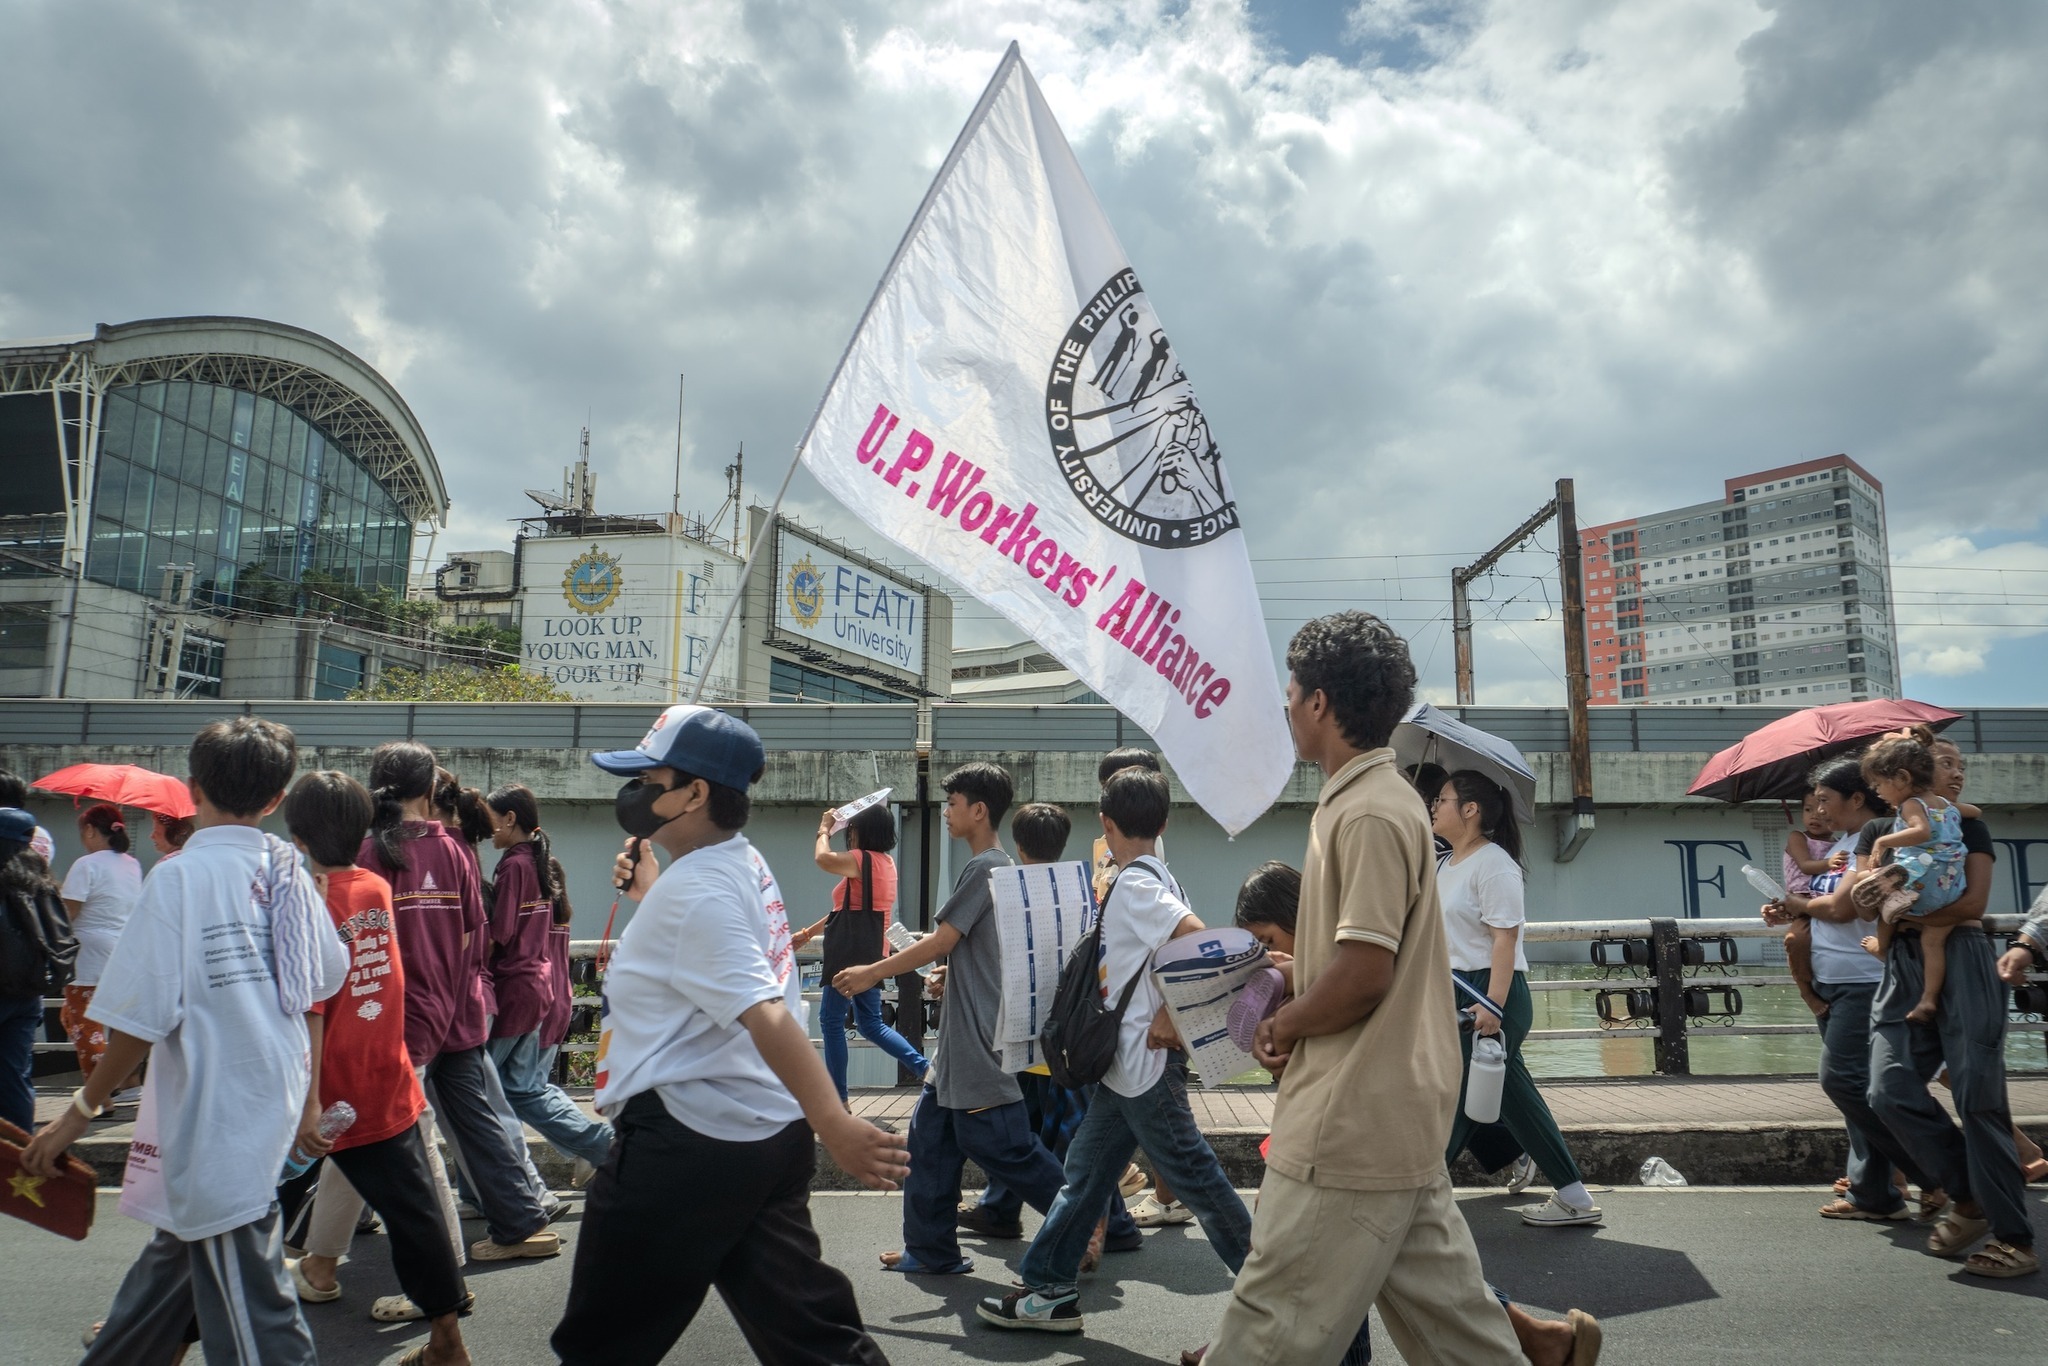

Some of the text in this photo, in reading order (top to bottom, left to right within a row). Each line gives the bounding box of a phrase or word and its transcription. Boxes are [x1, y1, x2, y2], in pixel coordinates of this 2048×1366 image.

[1052, 339, 1084, 385] THE
[1050, 399, 1069, 431] OF
[224, 431, 245, 550] FEATI
[856, 403, 1118, 608] U.P. Workers'
[1055, 444, 1162, 541] UNIVERSITY
[544, 615, 642, 637] LOOK UP,
[834, 565, 915, 636] FEATI
[525, 639, 658, 661] YOUNG MAN,
[834, 612, 912, 668] University
[1096, 578, 1231, 719] Alliance
[542, 664, 603, 684] LOOK
